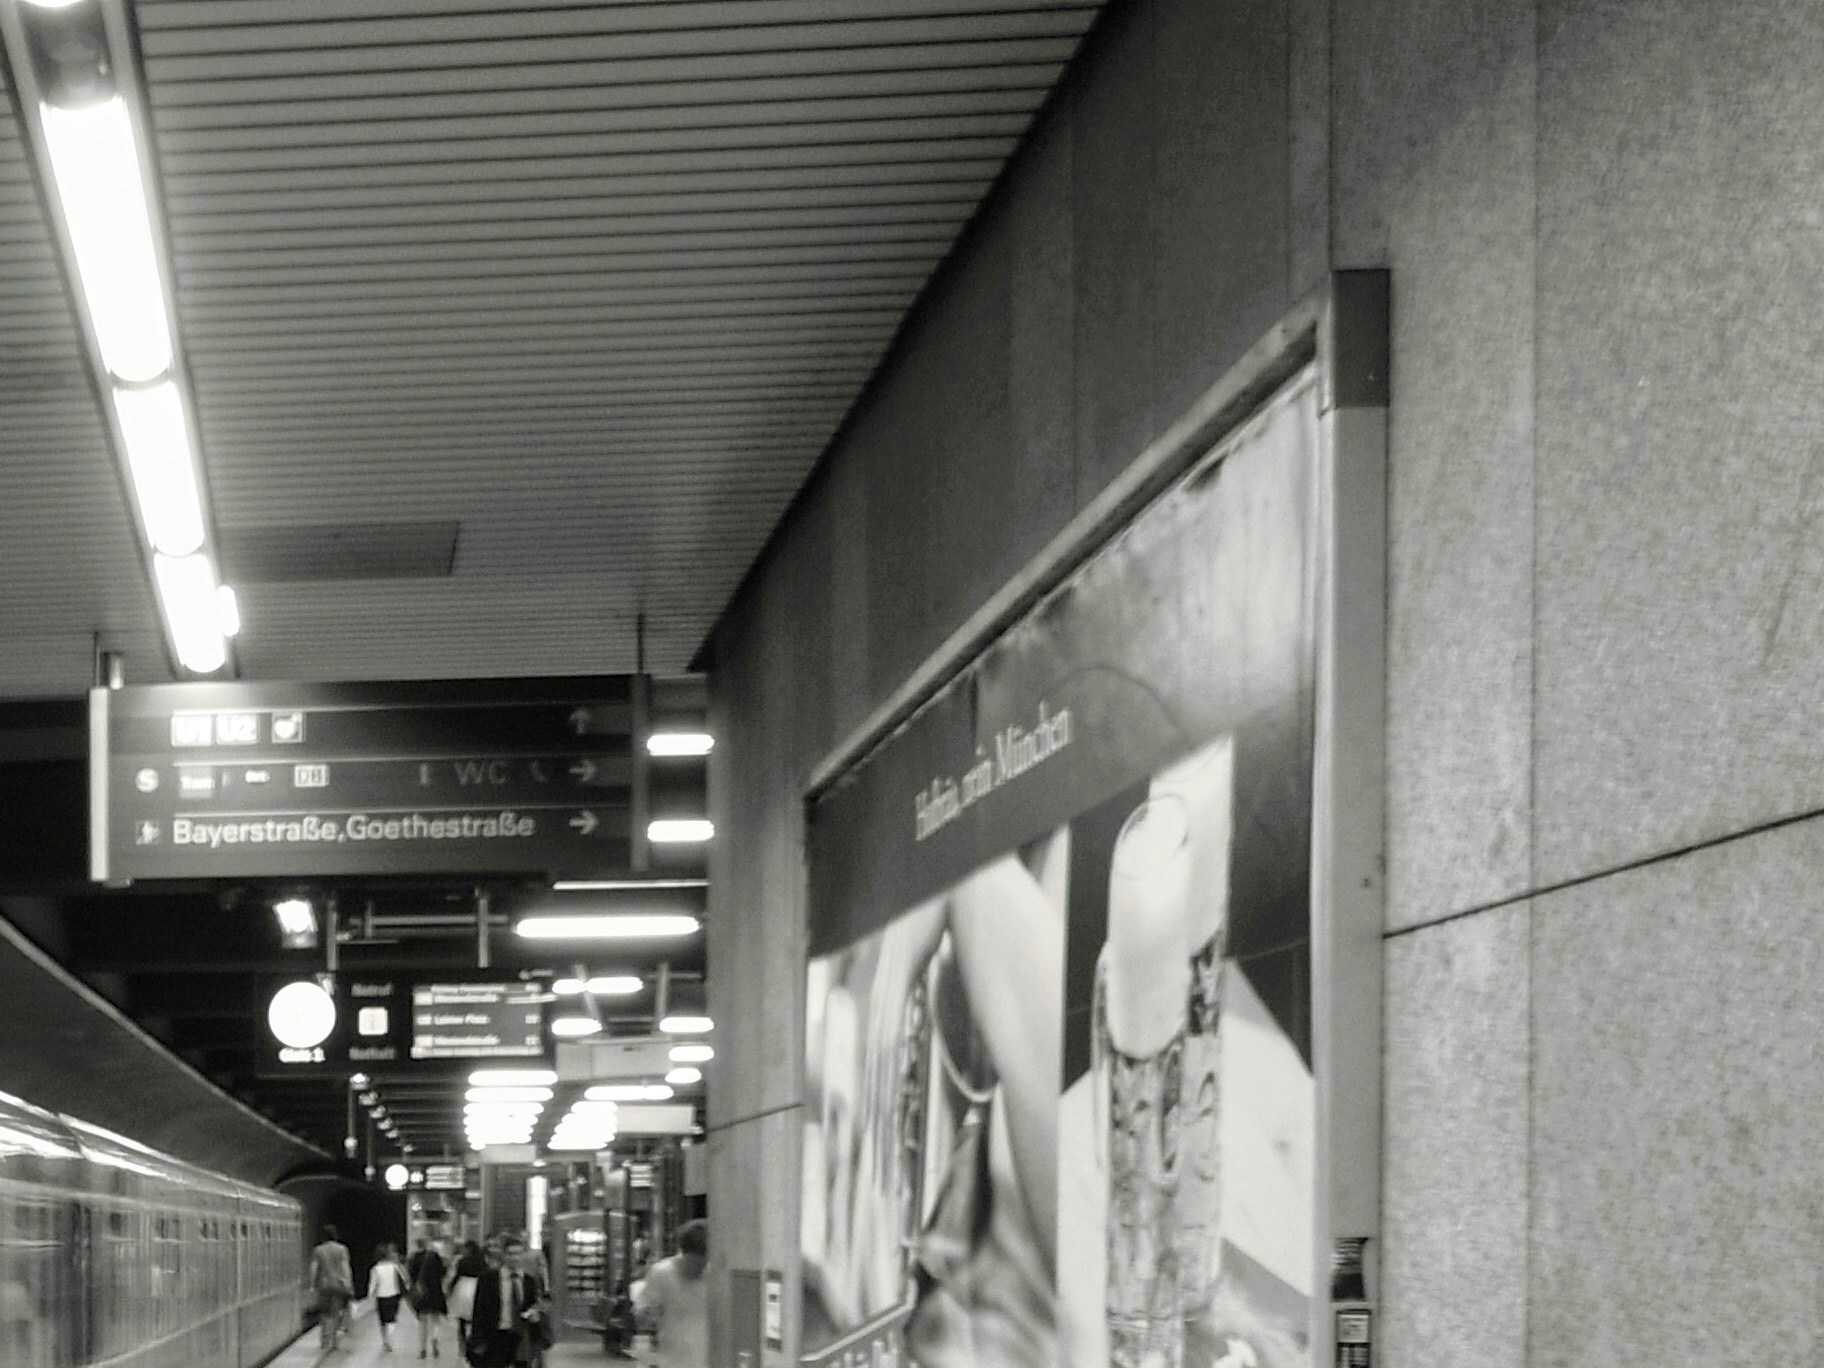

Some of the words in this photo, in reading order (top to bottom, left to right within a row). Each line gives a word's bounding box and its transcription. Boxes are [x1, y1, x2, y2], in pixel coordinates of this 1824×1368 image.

[993, 701, 1069, 786] München
[453, 760, 507, 785] WC
[346, 812, 535, 840] Goethestraße
